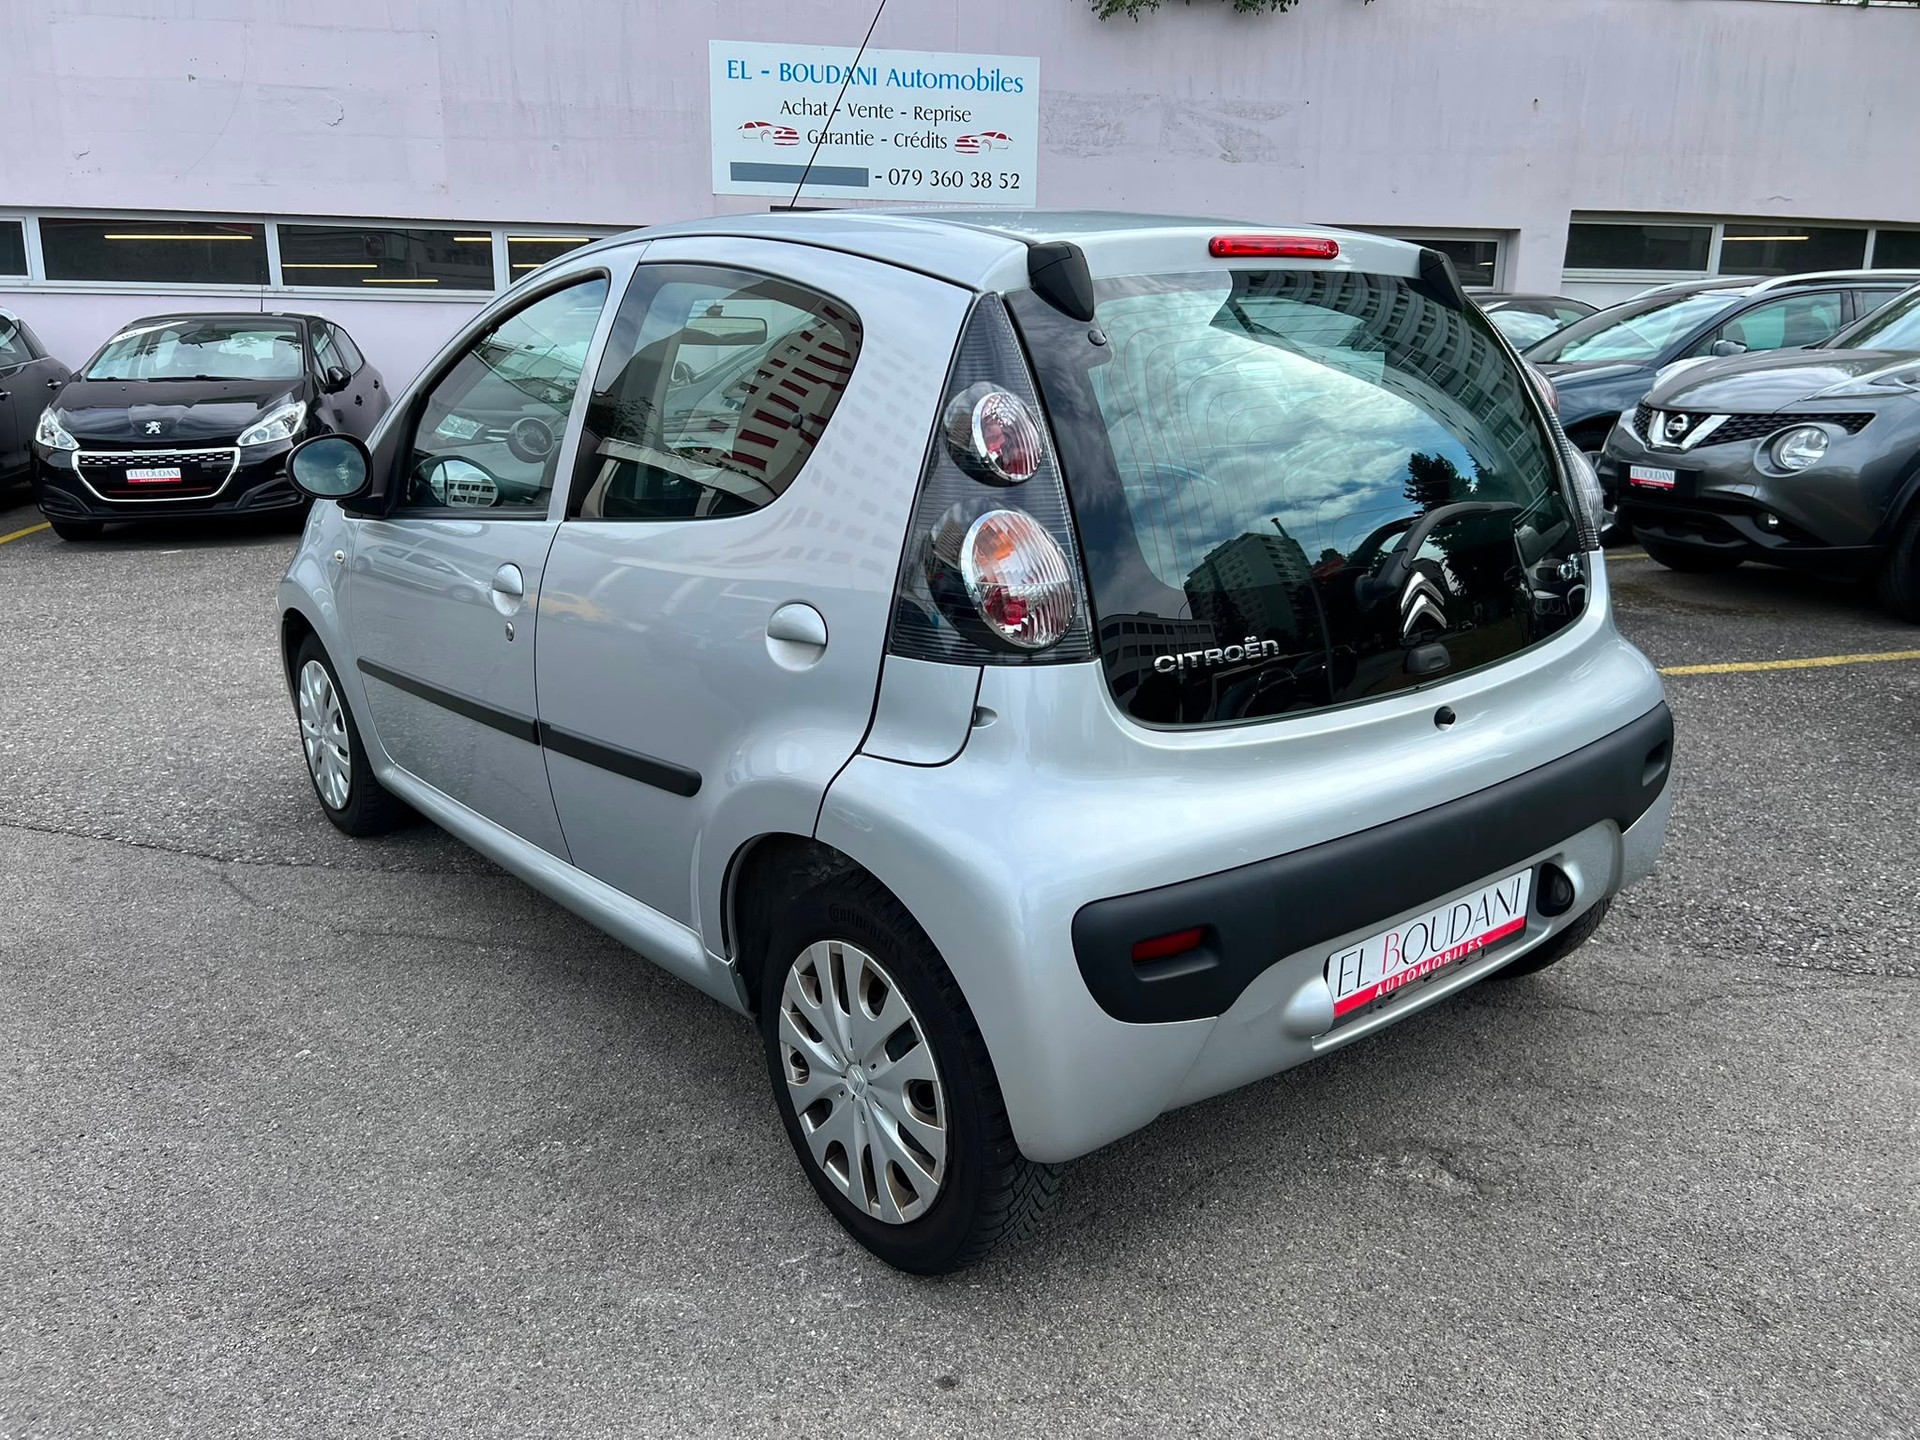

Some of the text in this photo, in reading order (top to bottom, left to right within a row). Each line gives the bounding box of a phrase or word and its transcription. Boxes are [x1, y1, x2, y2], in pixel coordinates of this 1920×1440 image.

[727, 60, 752, 80] EL
[779, 62, 877, 86] BOUDANI
[886, 68, 1024, 93] Automobiles
[780, 99, 828, 116] Achat
[847, 103, 894, 119] Vente
[913, 106, 971, 126] Reprise
[807, 129, 874, 146] Garantie
[894, 131, 948, 149] Crédits
[888, 168, 922, 186] 079
[929, 170, 964, 188] 360
[970, 172, 992, 189] 38
[998, 173, 1020, 190] 52
[1338, 877, 1521, 998] EL BOUDANI
[1374, 936, 1484, 998] AUTOMOBILES
